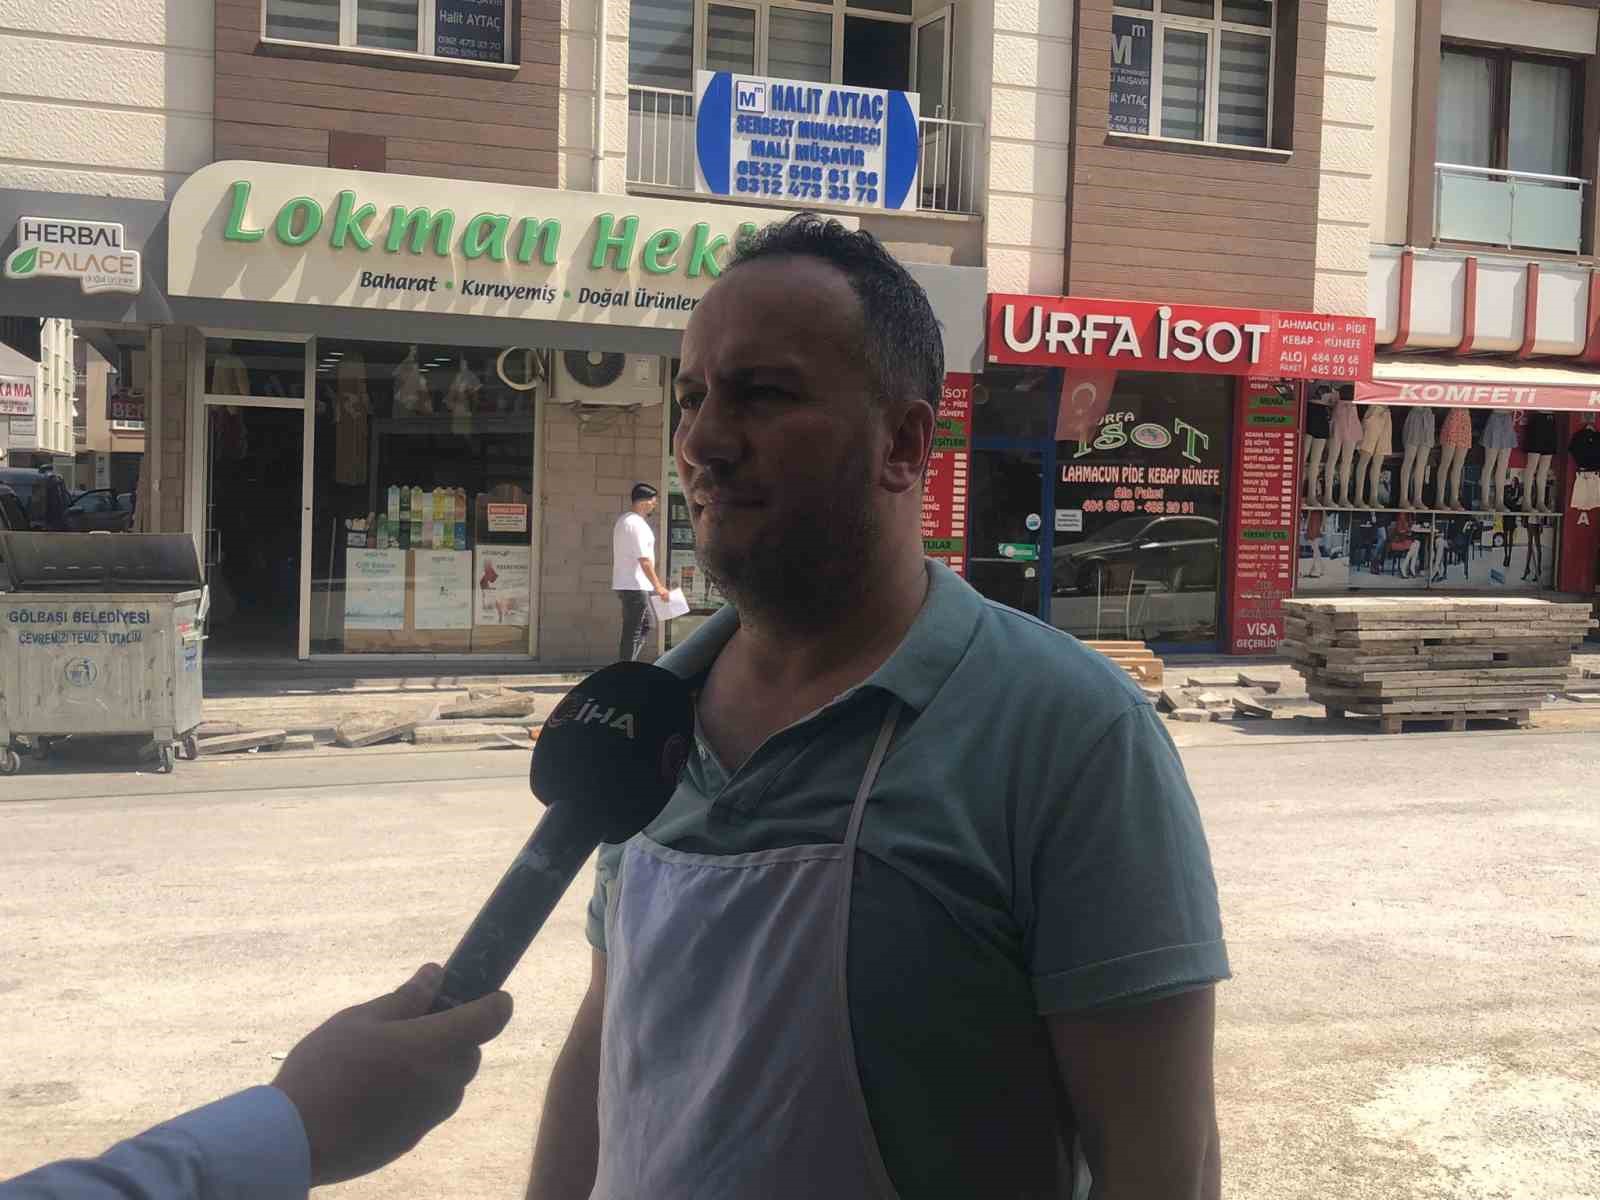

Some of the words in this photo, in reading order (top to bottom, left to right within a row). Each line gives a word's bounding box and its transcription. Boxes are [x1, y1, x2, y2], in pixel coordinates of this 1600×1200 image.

[771, 84, 823, 115] HALİT
[827, 90, 884, 124] AYTAÇ
[736, 114, 794, 138] SERBEST
[750, 138, 790, 159] MALİ
[795, 143, 865, 167] MÜŞAVİR
[736, 160, 783, 179] 0532
[736, 177, 783, 195] 0312
[788, 182, 822, 199] 473
[827, 185, 850, 201] 33
[855, 188, 878, 204] 70
[24, 222, 120, 247] HERBAL
[223, 180, 562, 265] Lokman
[39, 250, 135, 275] PALACE
[360, 271, 438, 292] Baharat
[461, 279, 557, 304] Kuruyemiş
[578, 287, 630, 309] Doğal
[1003, 304, 1143, 358] URFA
[1157, 305, 1271, 365] İSOT
[1278, 319, 1335, 333] LAHMACUN
[1345, 321, 1368, 335] PİDE
[1282, 335, 1314, 346] KEBAP
[1280, 351, 1302, 362] ALO
[1062, 465, 1120, 484] LAHMACUN
[1122, 463, 1145, 484] PİDE
[1148, 466, 1180, 485] KEBAP
[1182, 465, 1220, 486] KÜNEFE
[9, 608, 67, 625] GÖLBAŞI
[72, 608, 151, 624] BELEDİYESİ
[573, 698, 635, 740] İHA
